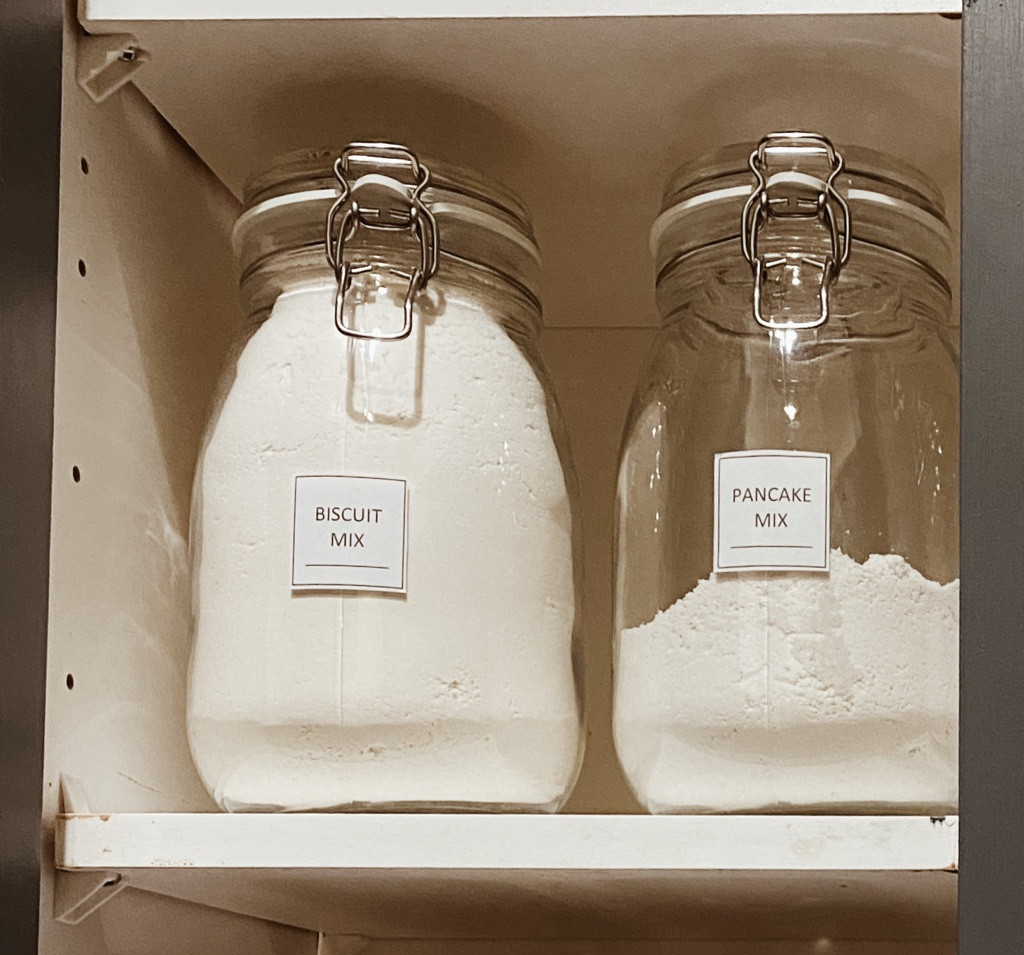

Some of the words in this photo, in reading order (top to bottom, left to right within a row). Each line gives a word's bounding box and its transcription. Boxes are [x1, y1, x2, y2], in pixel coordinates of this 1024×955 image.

[732, 486, 812, 504] PANCAKE
[315, 506, 383, 524] BISCUIT
[754, 512, 789, 528] MIX
[330, 532, 365, 549] MIX
